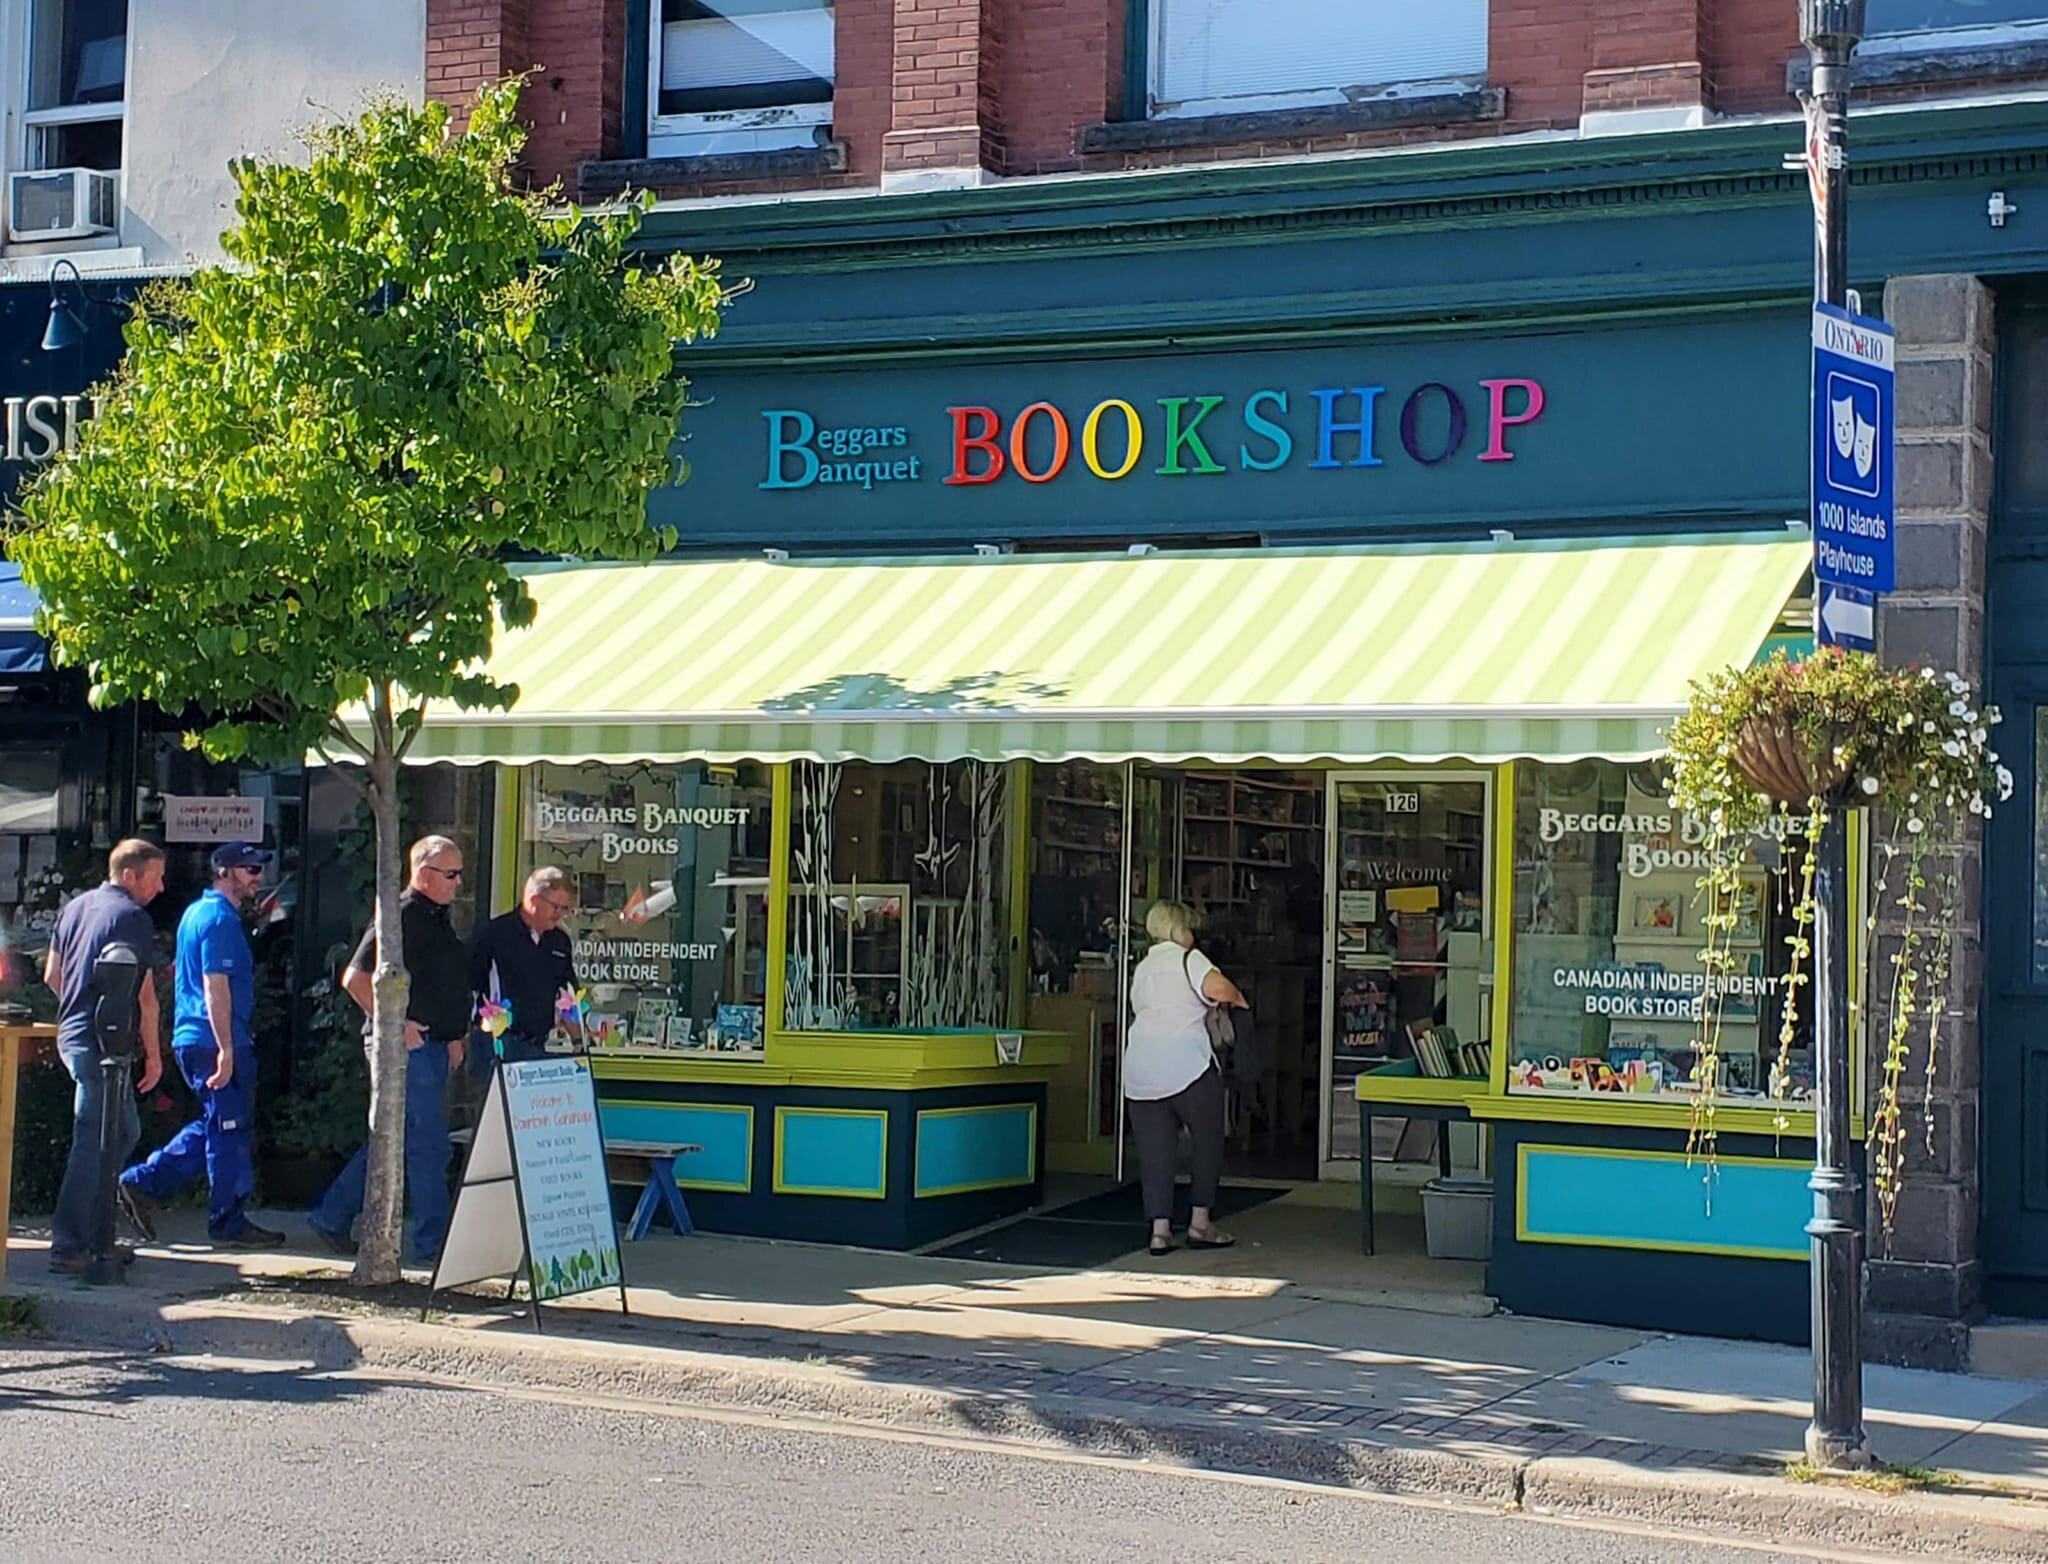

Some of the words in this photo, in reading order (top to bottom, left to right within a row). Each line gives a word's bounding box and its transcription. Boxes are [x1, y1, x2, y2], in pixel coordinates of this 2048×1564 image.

[1825, 319, 1884, 362] ONTARIO
[0, 395, 106, 460] ISH
[942, 378, 1544, 485] BOOKSHOP
[758, 410, 906, 489] Beggars
[1819, 501, 1845, 532] 1000
[1847, 506, 1886, 540] Islands
[1819, 540, 1875, 577] Playhouse
[535, 802, 638, 831] BEGGARS
[643, 803, 750, 833] BANQUET
[1388, 794, 1417, 811] 126
[1540, 807, 1672, 842] BEGGARS
[602, 832, 680, 863] BOOKS
[1627, 844, 1729, 878] BOOKS
[1367, 861, 1453, 882] Welcome
[620, 941, 718, 960] INDEPENDENT
[612, 964, 660, 981] STORE
[1553, 969, 1645, 990] CANADIAN
[1650, 973, 1779, 996] INDEPENDENT
[1585, 995, 1638, 1014] BOOK
